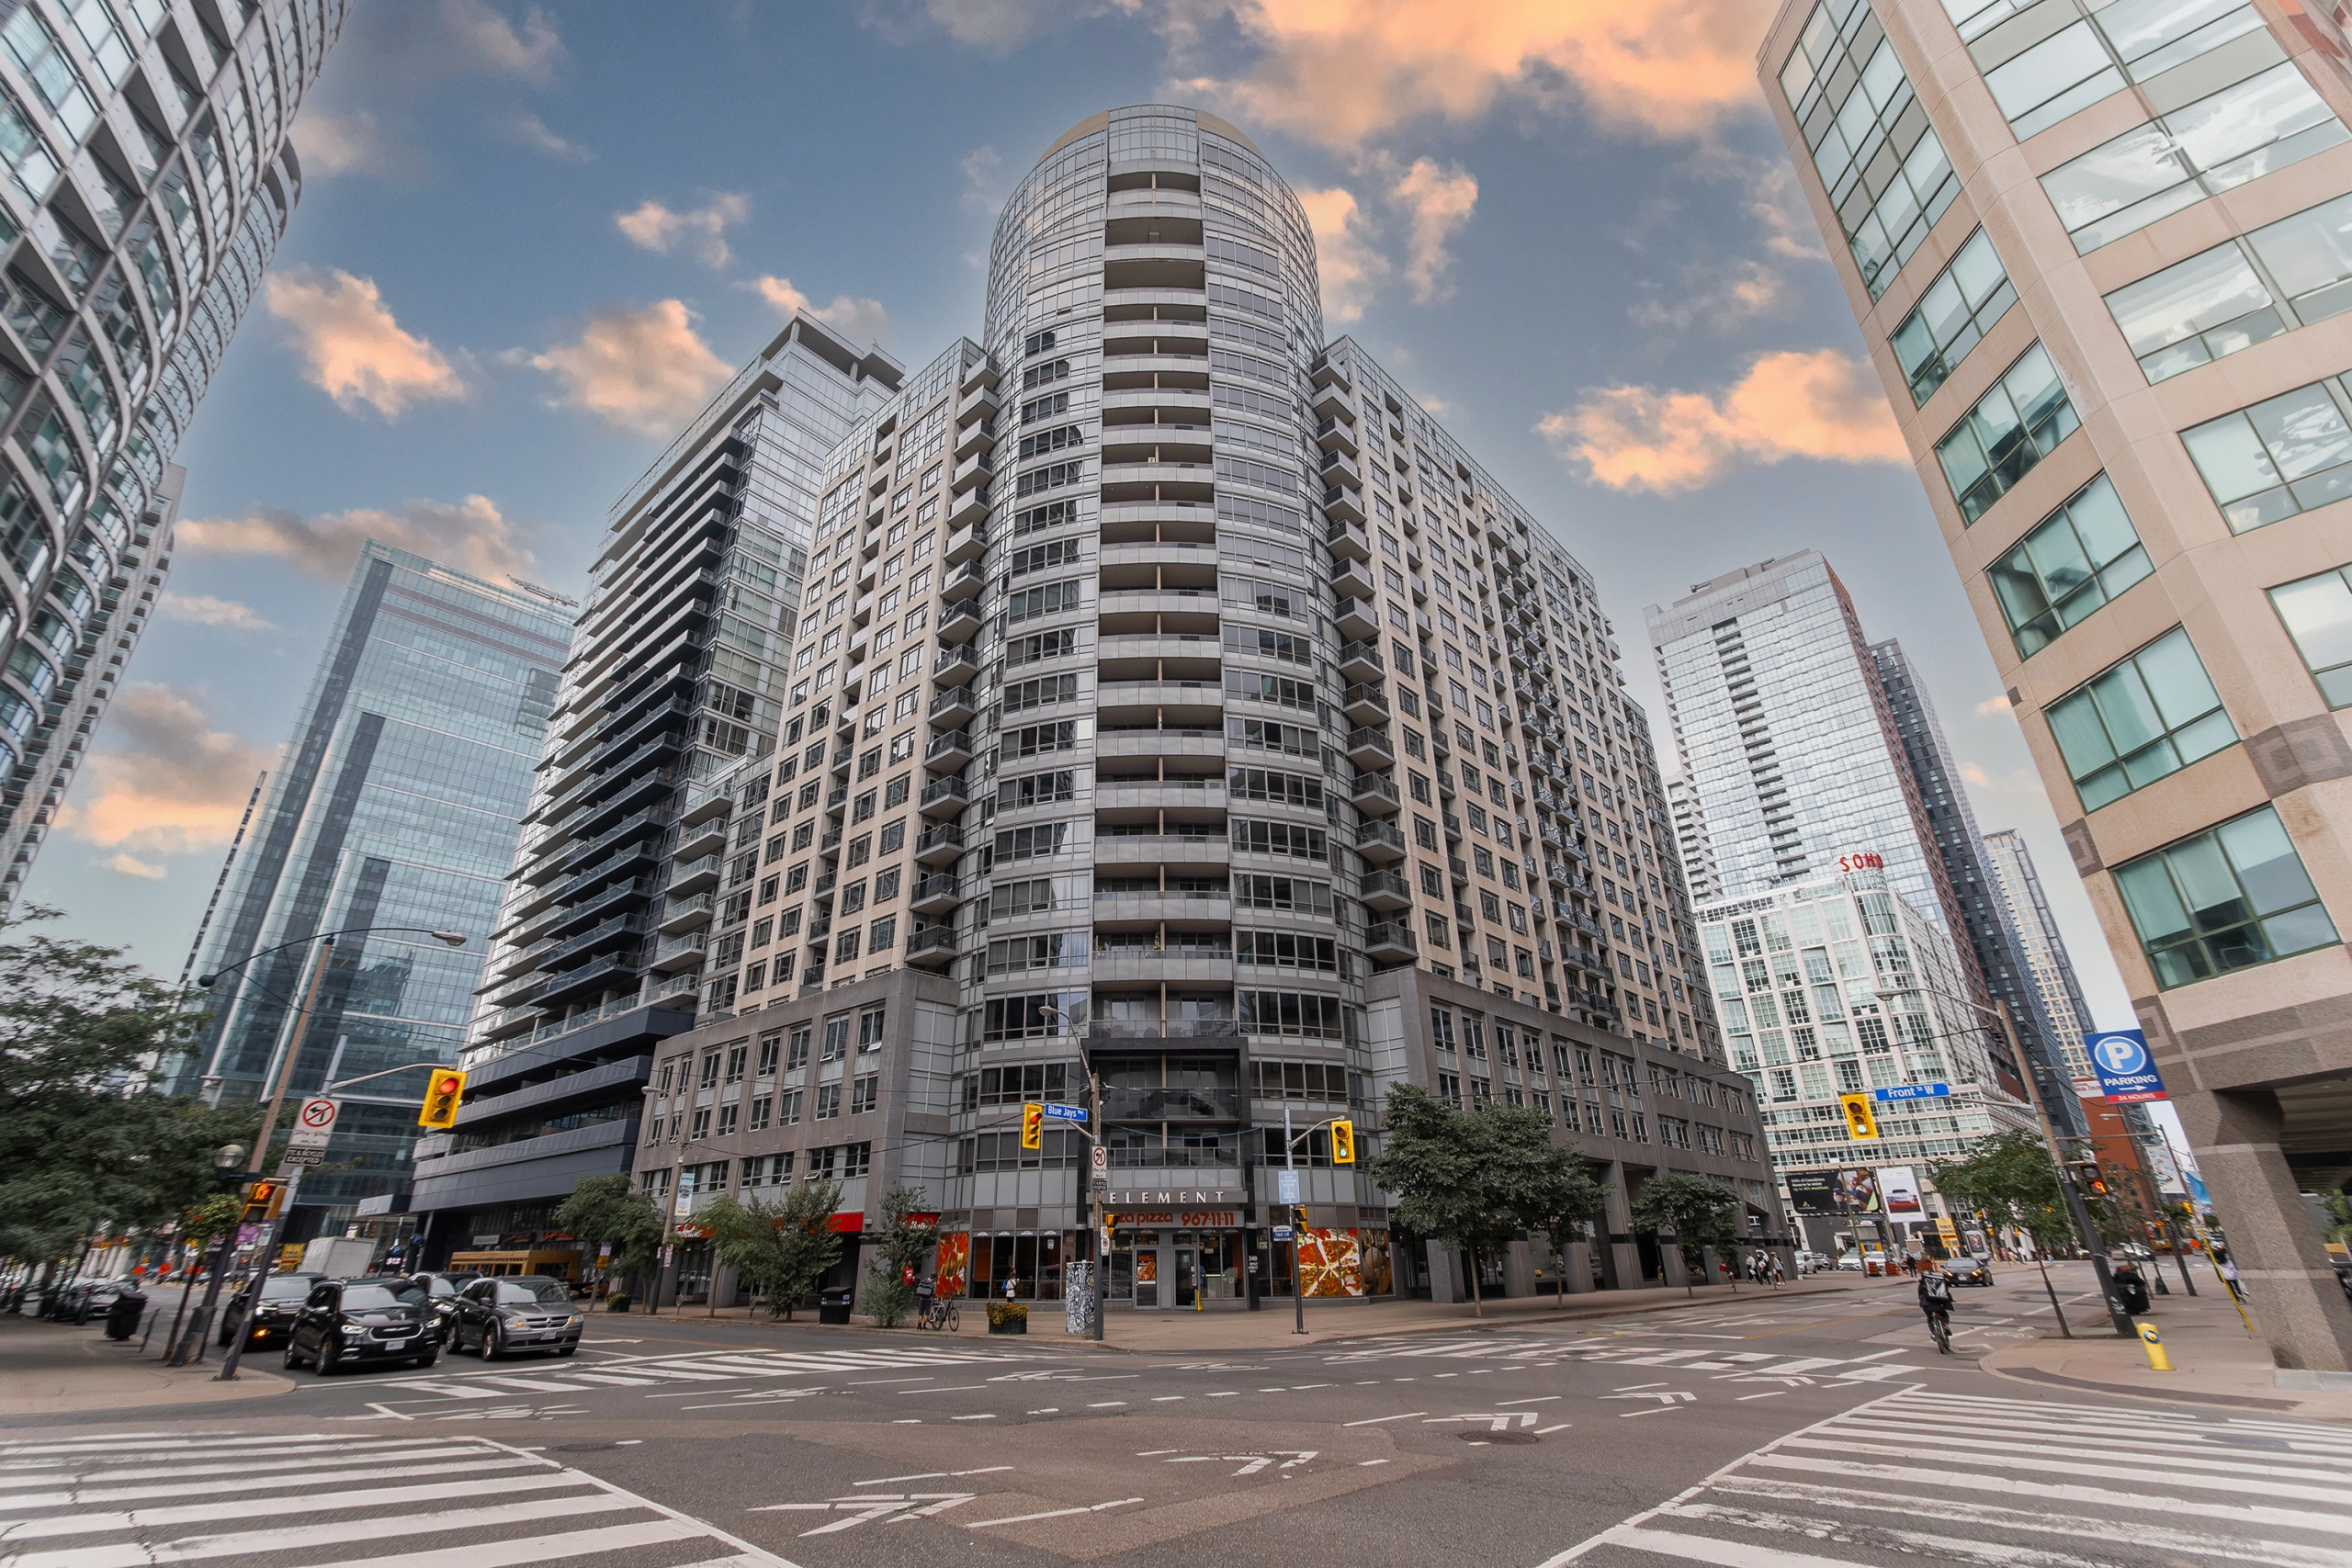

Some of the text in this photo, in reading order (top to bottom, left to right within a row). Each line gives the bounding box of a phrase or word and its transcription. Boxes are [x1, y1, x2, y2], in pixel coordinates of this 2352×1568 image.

[1838, 852, 1884, 873] SOHO
[2104, 1042, 2133, 1069] P
[2103, 1074, 2158, 1087] PARKING
[1886, 1087, 1916, 1098] Front
[1923, 1085, 1934, 1094] W
[1048, 1105, 1062, 1116] Blue
[1063, 1108, 1076, 1119] Jays
[1109, 1191, 1224, 1204] ELEMENT
[1137, 1212, 1173, 1226] pizza
